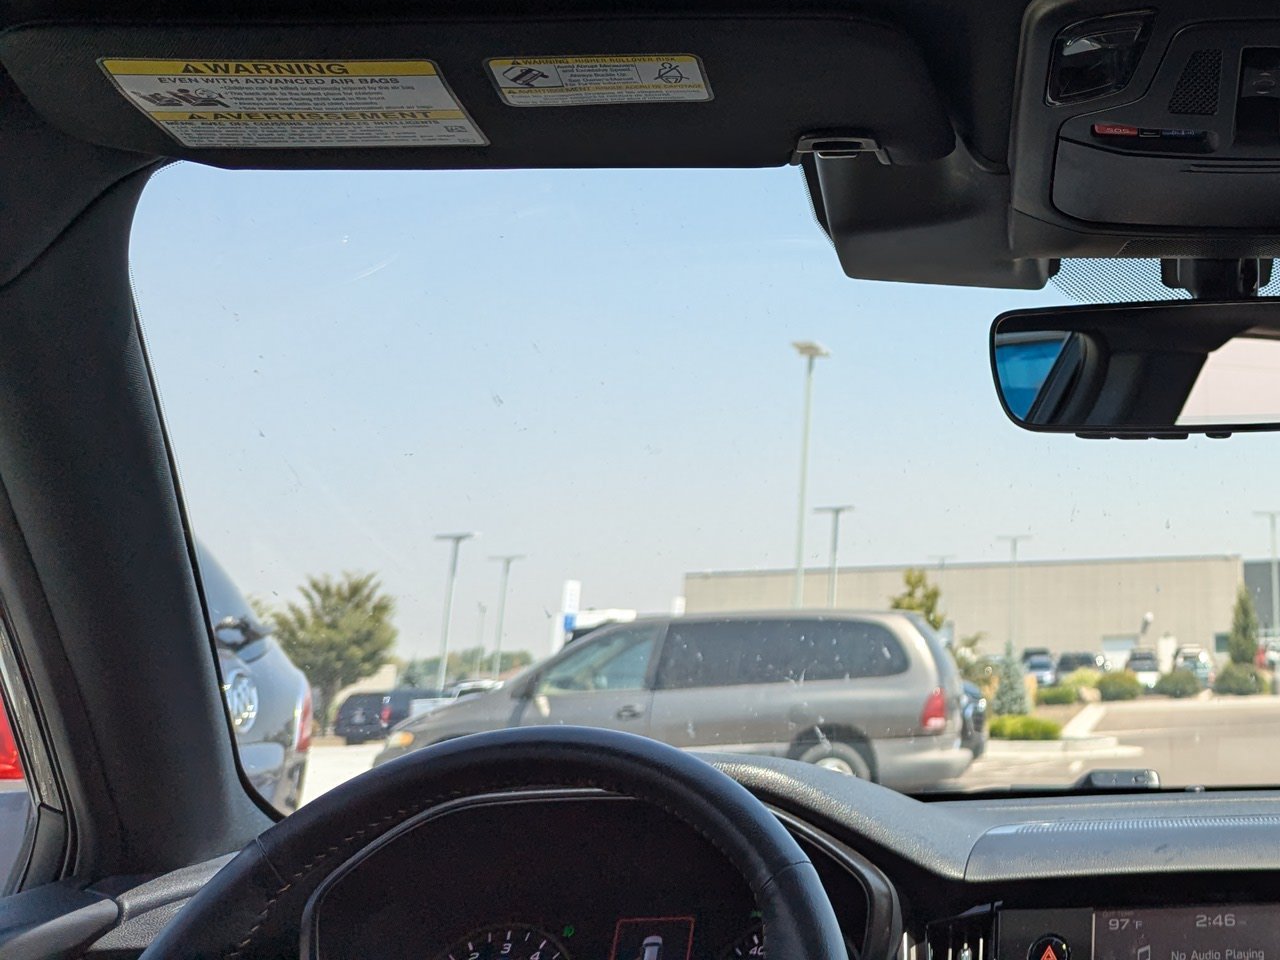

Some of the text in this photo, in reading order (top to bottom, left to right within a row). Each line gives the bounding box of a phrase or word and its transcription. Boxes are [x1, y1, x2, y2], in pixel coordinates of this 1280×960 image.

[202, 63, 350, 75] WARNING
[157, 77, 199, 85] EVEN
[199, 77, 241, 85] WITH
[245, 77, 325, 85] ADVANCED
[330, 77, 355, 85] AIR
[213, 111, 432, 120] AVERTISSEMENT
[1108, 918, 1130, 931] 97
[1195, 913, 1236, 928] 2:46
[500, 943, 512, 954] 3
[1171, 948, 1265, 960] No Audio Playing
